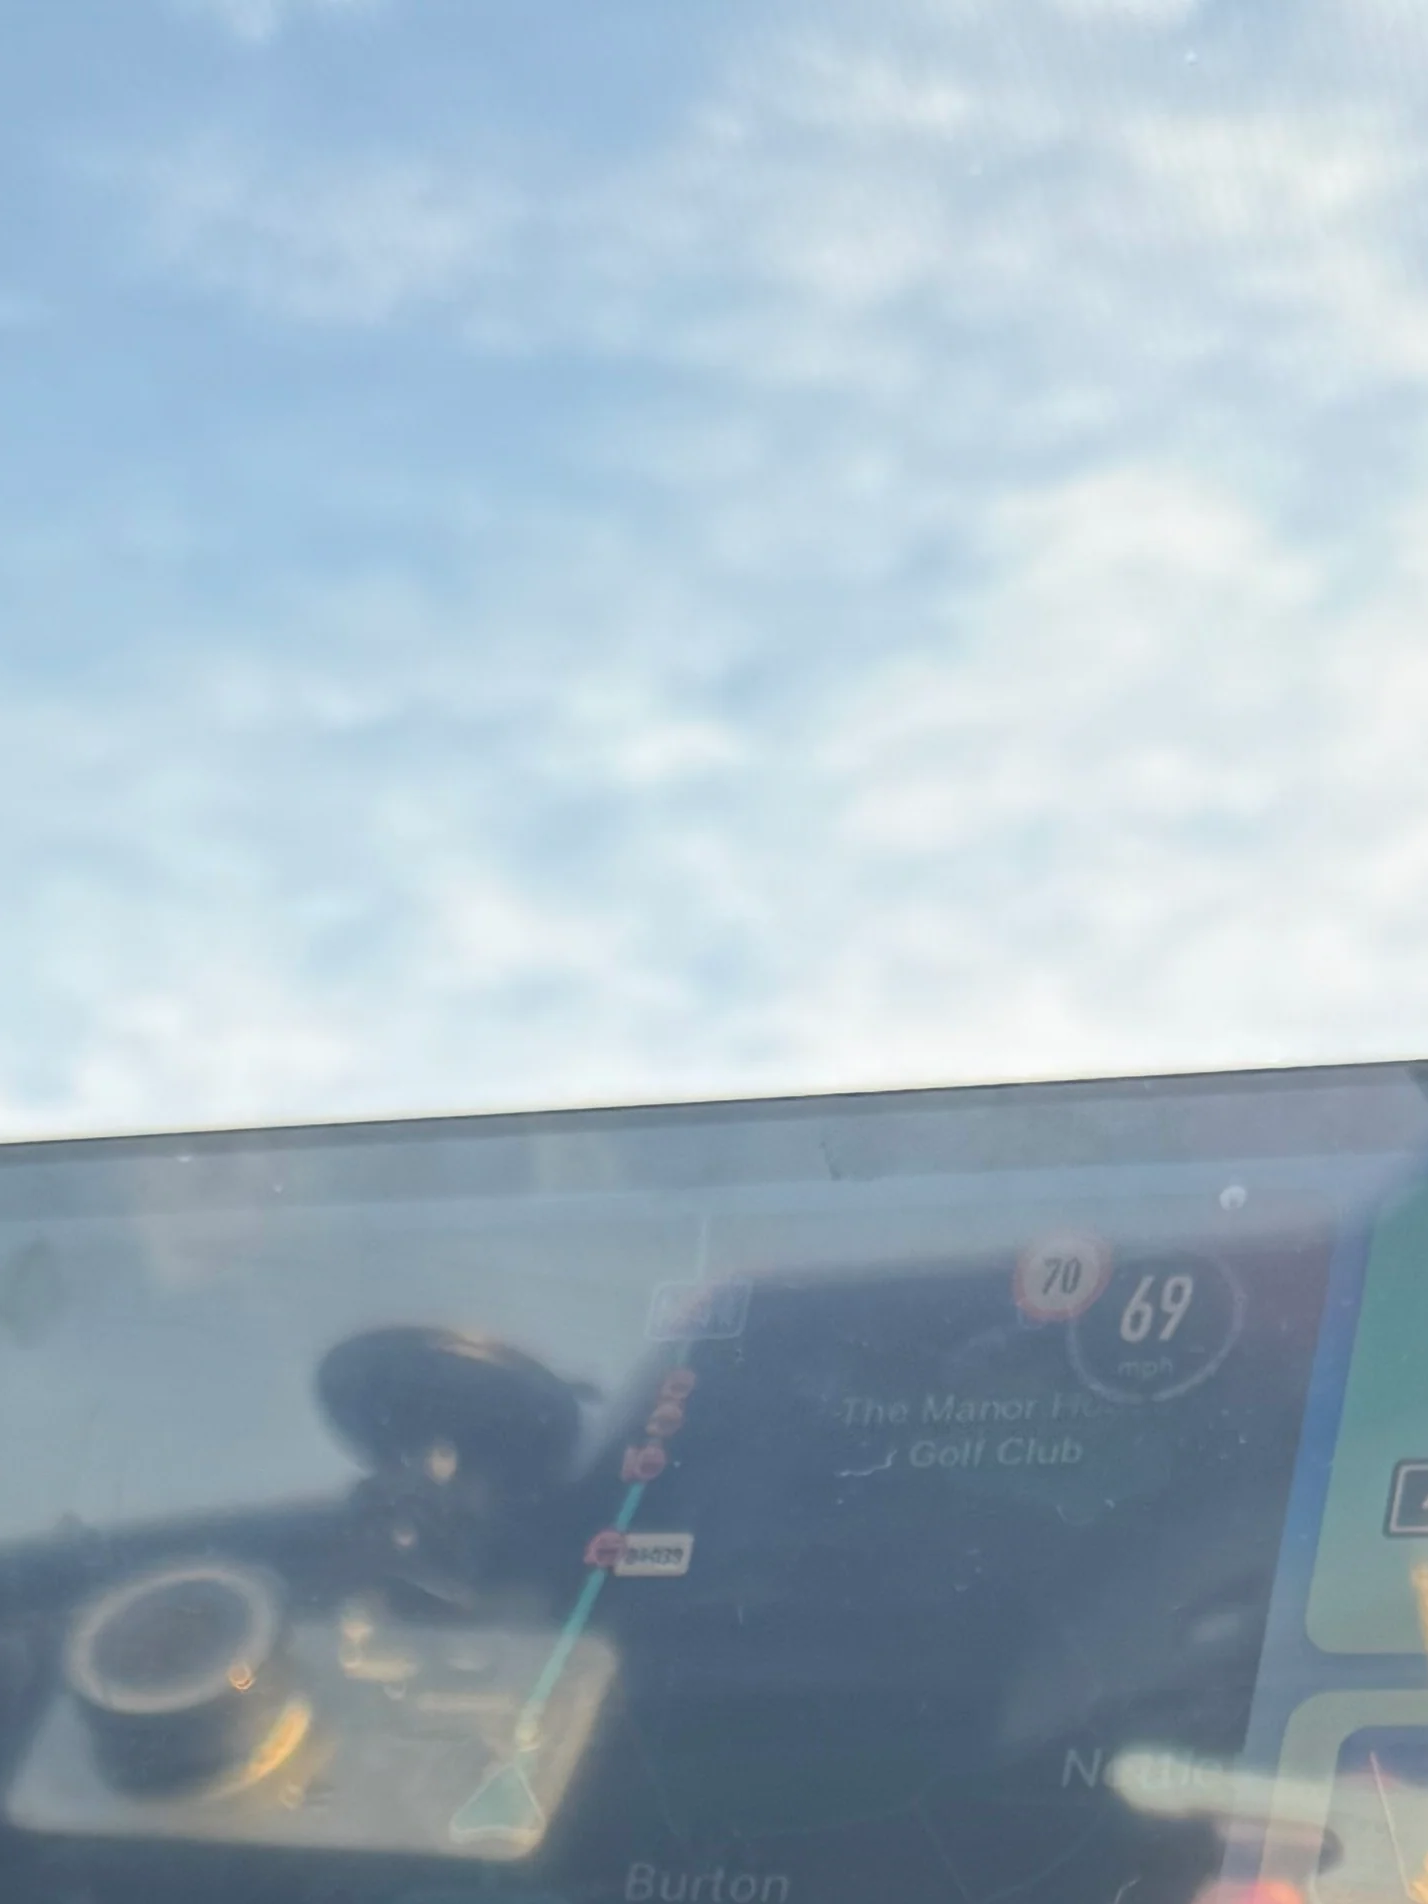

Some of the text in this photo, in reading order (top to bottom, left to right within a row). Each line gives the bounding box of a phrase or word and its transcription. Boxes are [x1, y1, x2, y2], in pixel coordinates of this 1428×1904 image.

[1042, 1258, 1082, 1296] 70
[1120, 1274, 1193, 1343] 69
[997, 1436, 1083, 1466] Club
[624, 1861, 791, 1904] Burton
